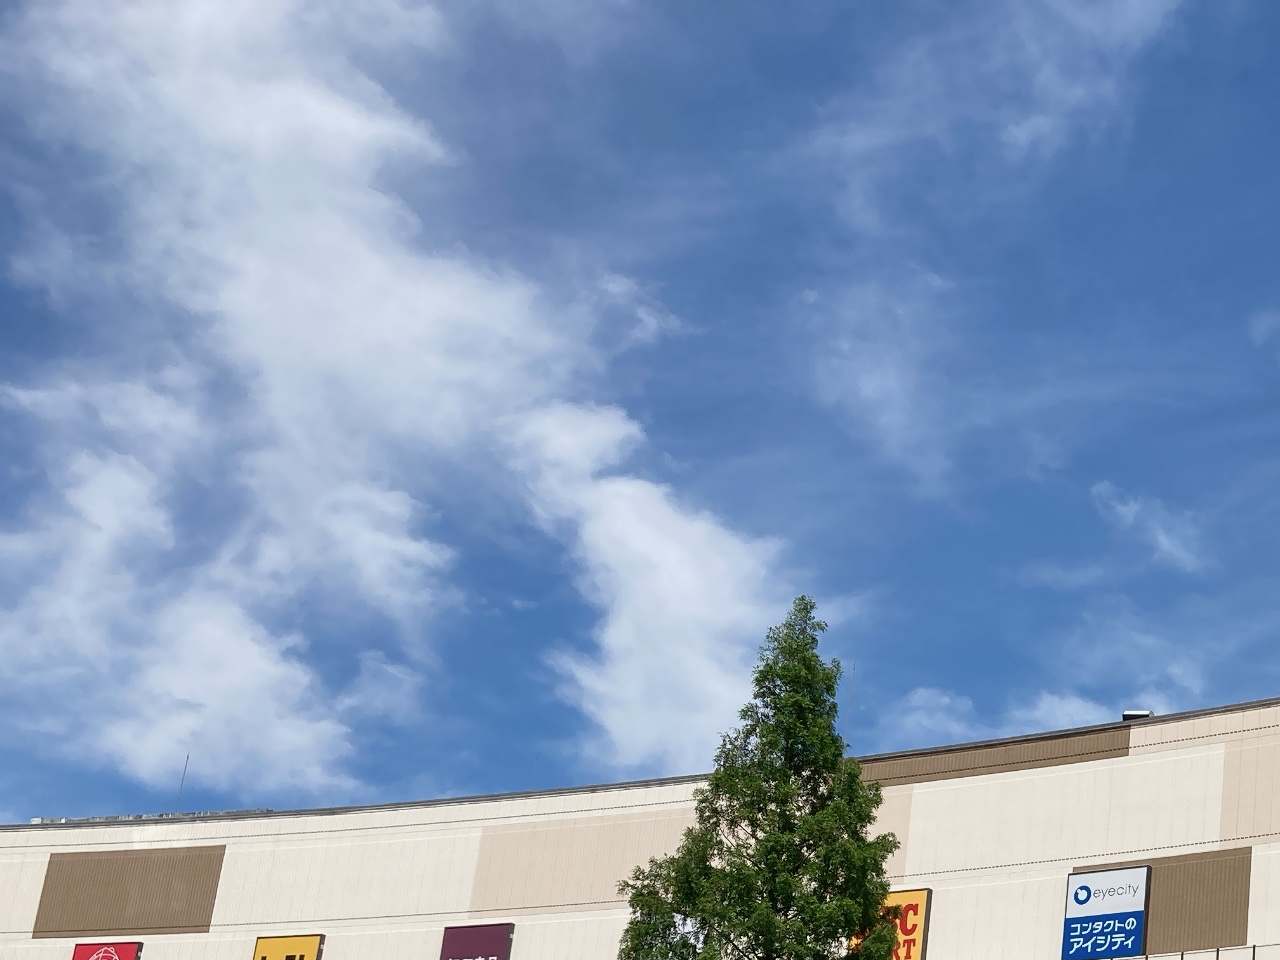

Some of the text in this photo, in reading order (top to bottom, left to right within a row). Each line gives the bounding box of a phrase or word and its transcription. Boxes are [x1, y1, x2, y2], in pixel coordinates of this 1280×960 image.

[1092, 883, 1139, 900] eyecity
[1070, 917, 1137, 935] コンタクトの
[1069, 934, 1136, 955] アイシティ
